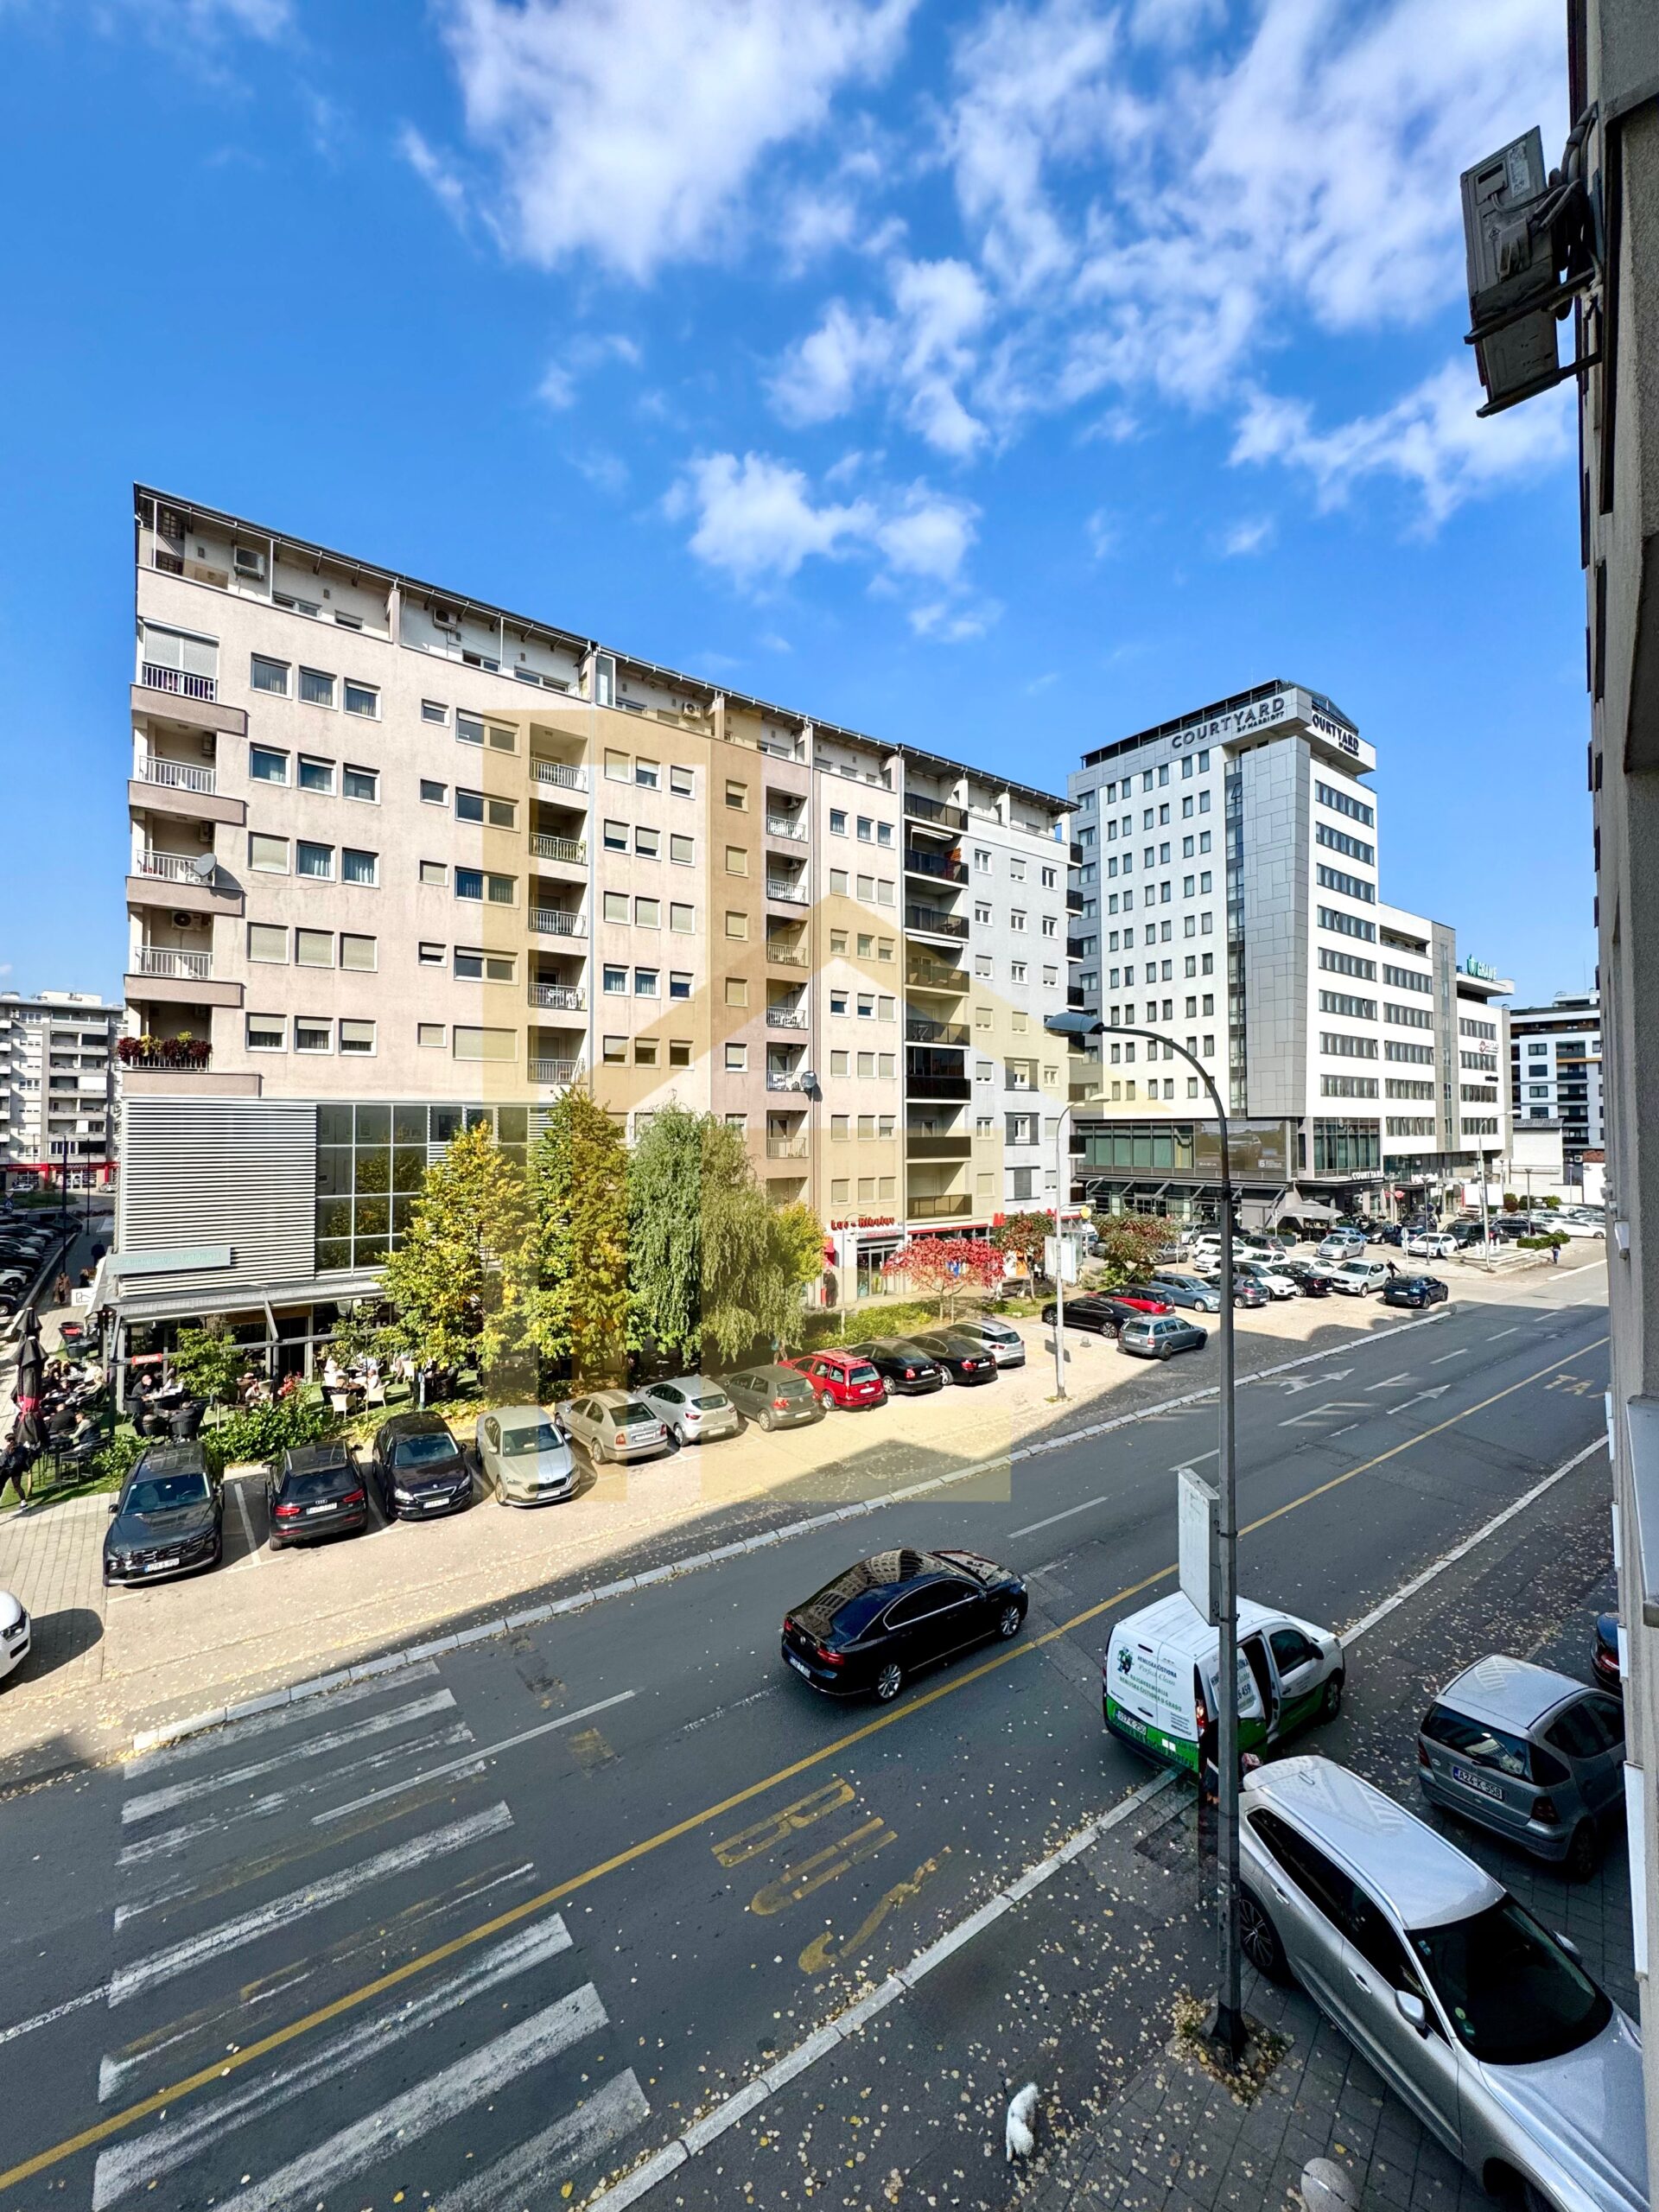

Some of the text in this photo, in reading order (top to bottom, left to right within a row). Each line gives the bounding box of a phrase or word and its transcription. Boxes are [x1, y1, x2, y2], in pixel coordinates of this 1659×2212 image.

[1171, 696, 1285, 749] COURTYARD
[1237, 711, 1285, 733] BY MARRIOTT
[1312, 713, 1359, 752] OURTYARD
[711, 1778, 952, 1975] BUS
